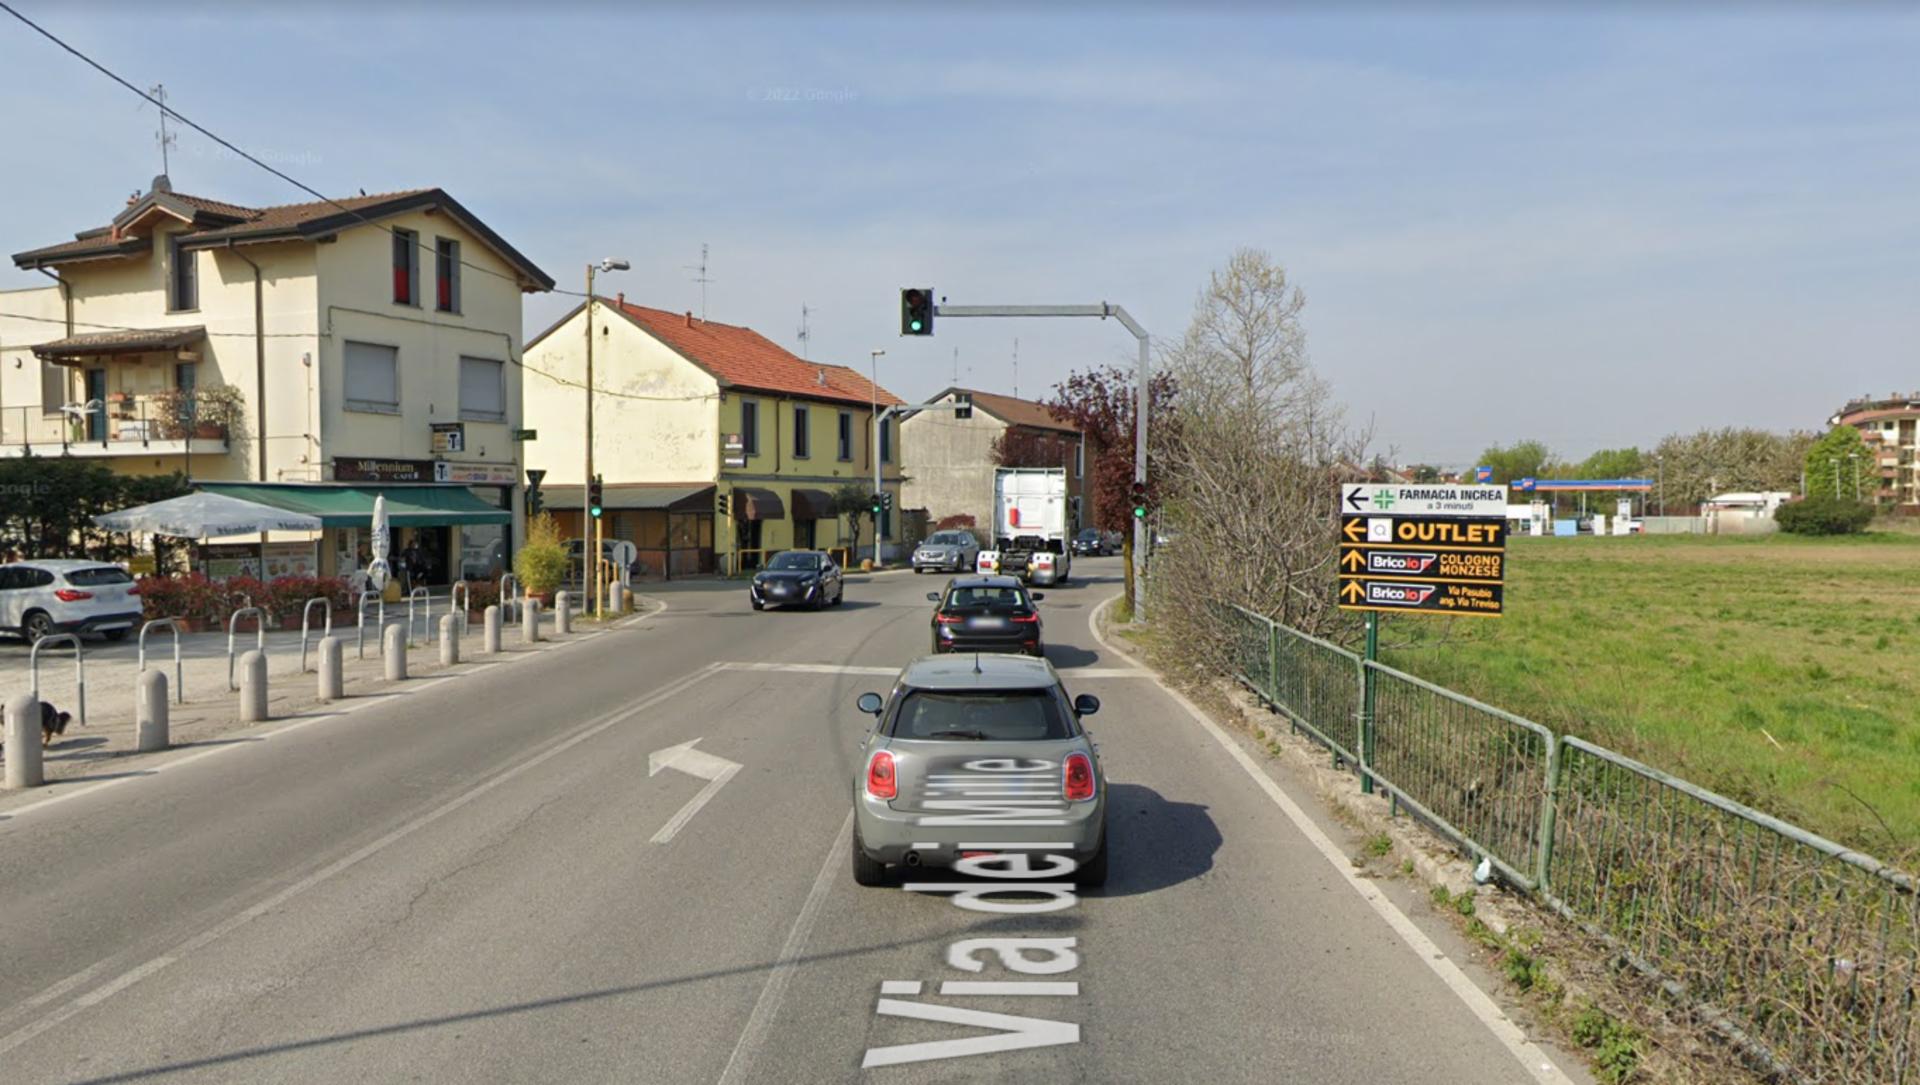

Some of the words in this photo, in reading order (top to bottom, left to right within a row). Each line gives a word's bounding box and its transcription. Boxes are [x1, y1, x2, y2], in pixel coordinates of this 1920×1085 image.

[357, 460, 414, 472] Millennium
[1399, 489, 1457, 500] FARMACIA
[1461, 489, 1503, 501] INCREA
[1435, 502, 1442, 510] 3
[1443, 502, 1474, 510] minuti
[1398, 522, 1500, 543] OUTLET
[1439, 554, 1500, 566] COLOGNO
[1439, 566, 1500, 577] MONZESE
[1448, 586, 1460, 596] Via
[1457, 597, 1469, 607] Via
